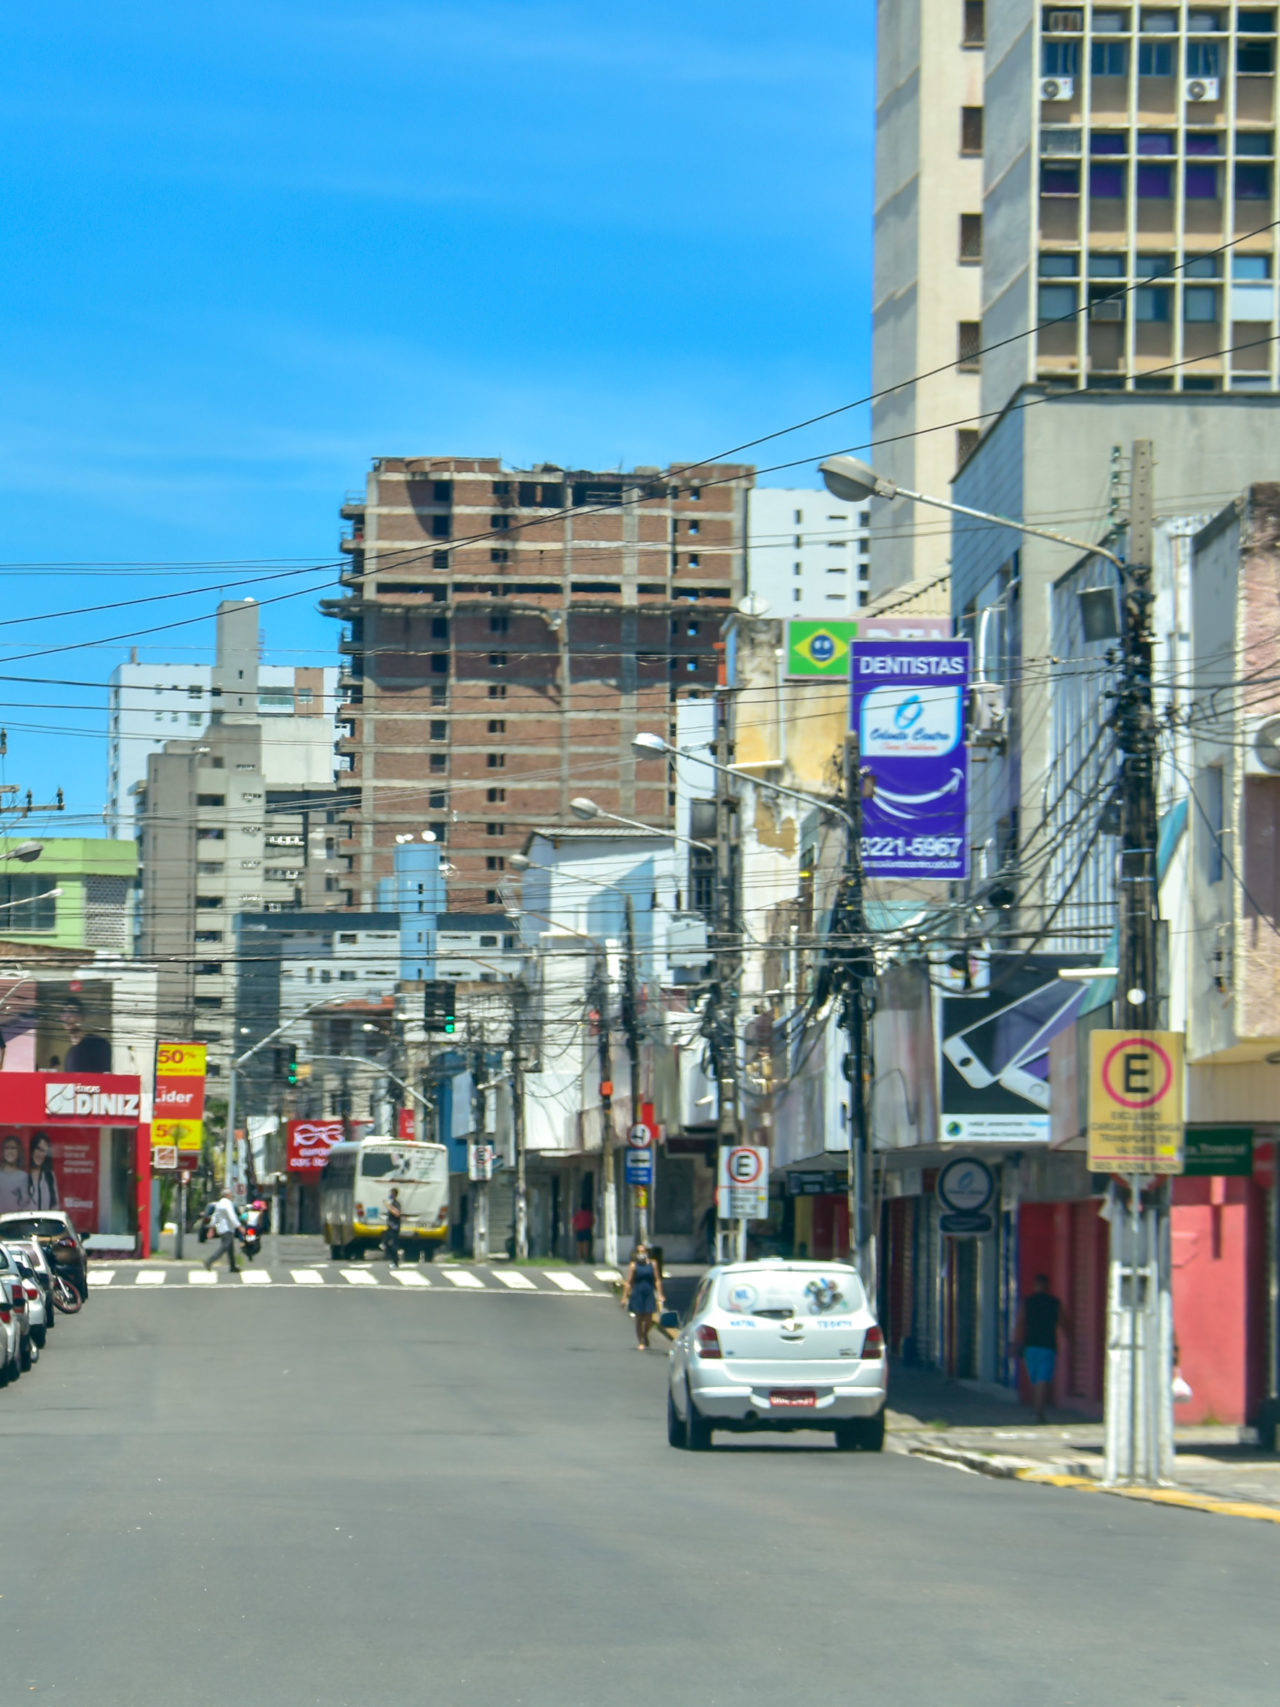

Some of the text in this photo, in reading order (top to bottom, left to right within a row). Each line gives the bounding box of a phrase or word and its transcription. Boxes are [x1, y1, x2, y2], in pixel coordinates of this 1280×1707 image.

[860, 656, 964, 674] DENTISTAS
[1124, 1053, 1149, 1093] E
[76, 1094, 139, 1116] DINIZ
[737, 1155, 750, 1176] E
